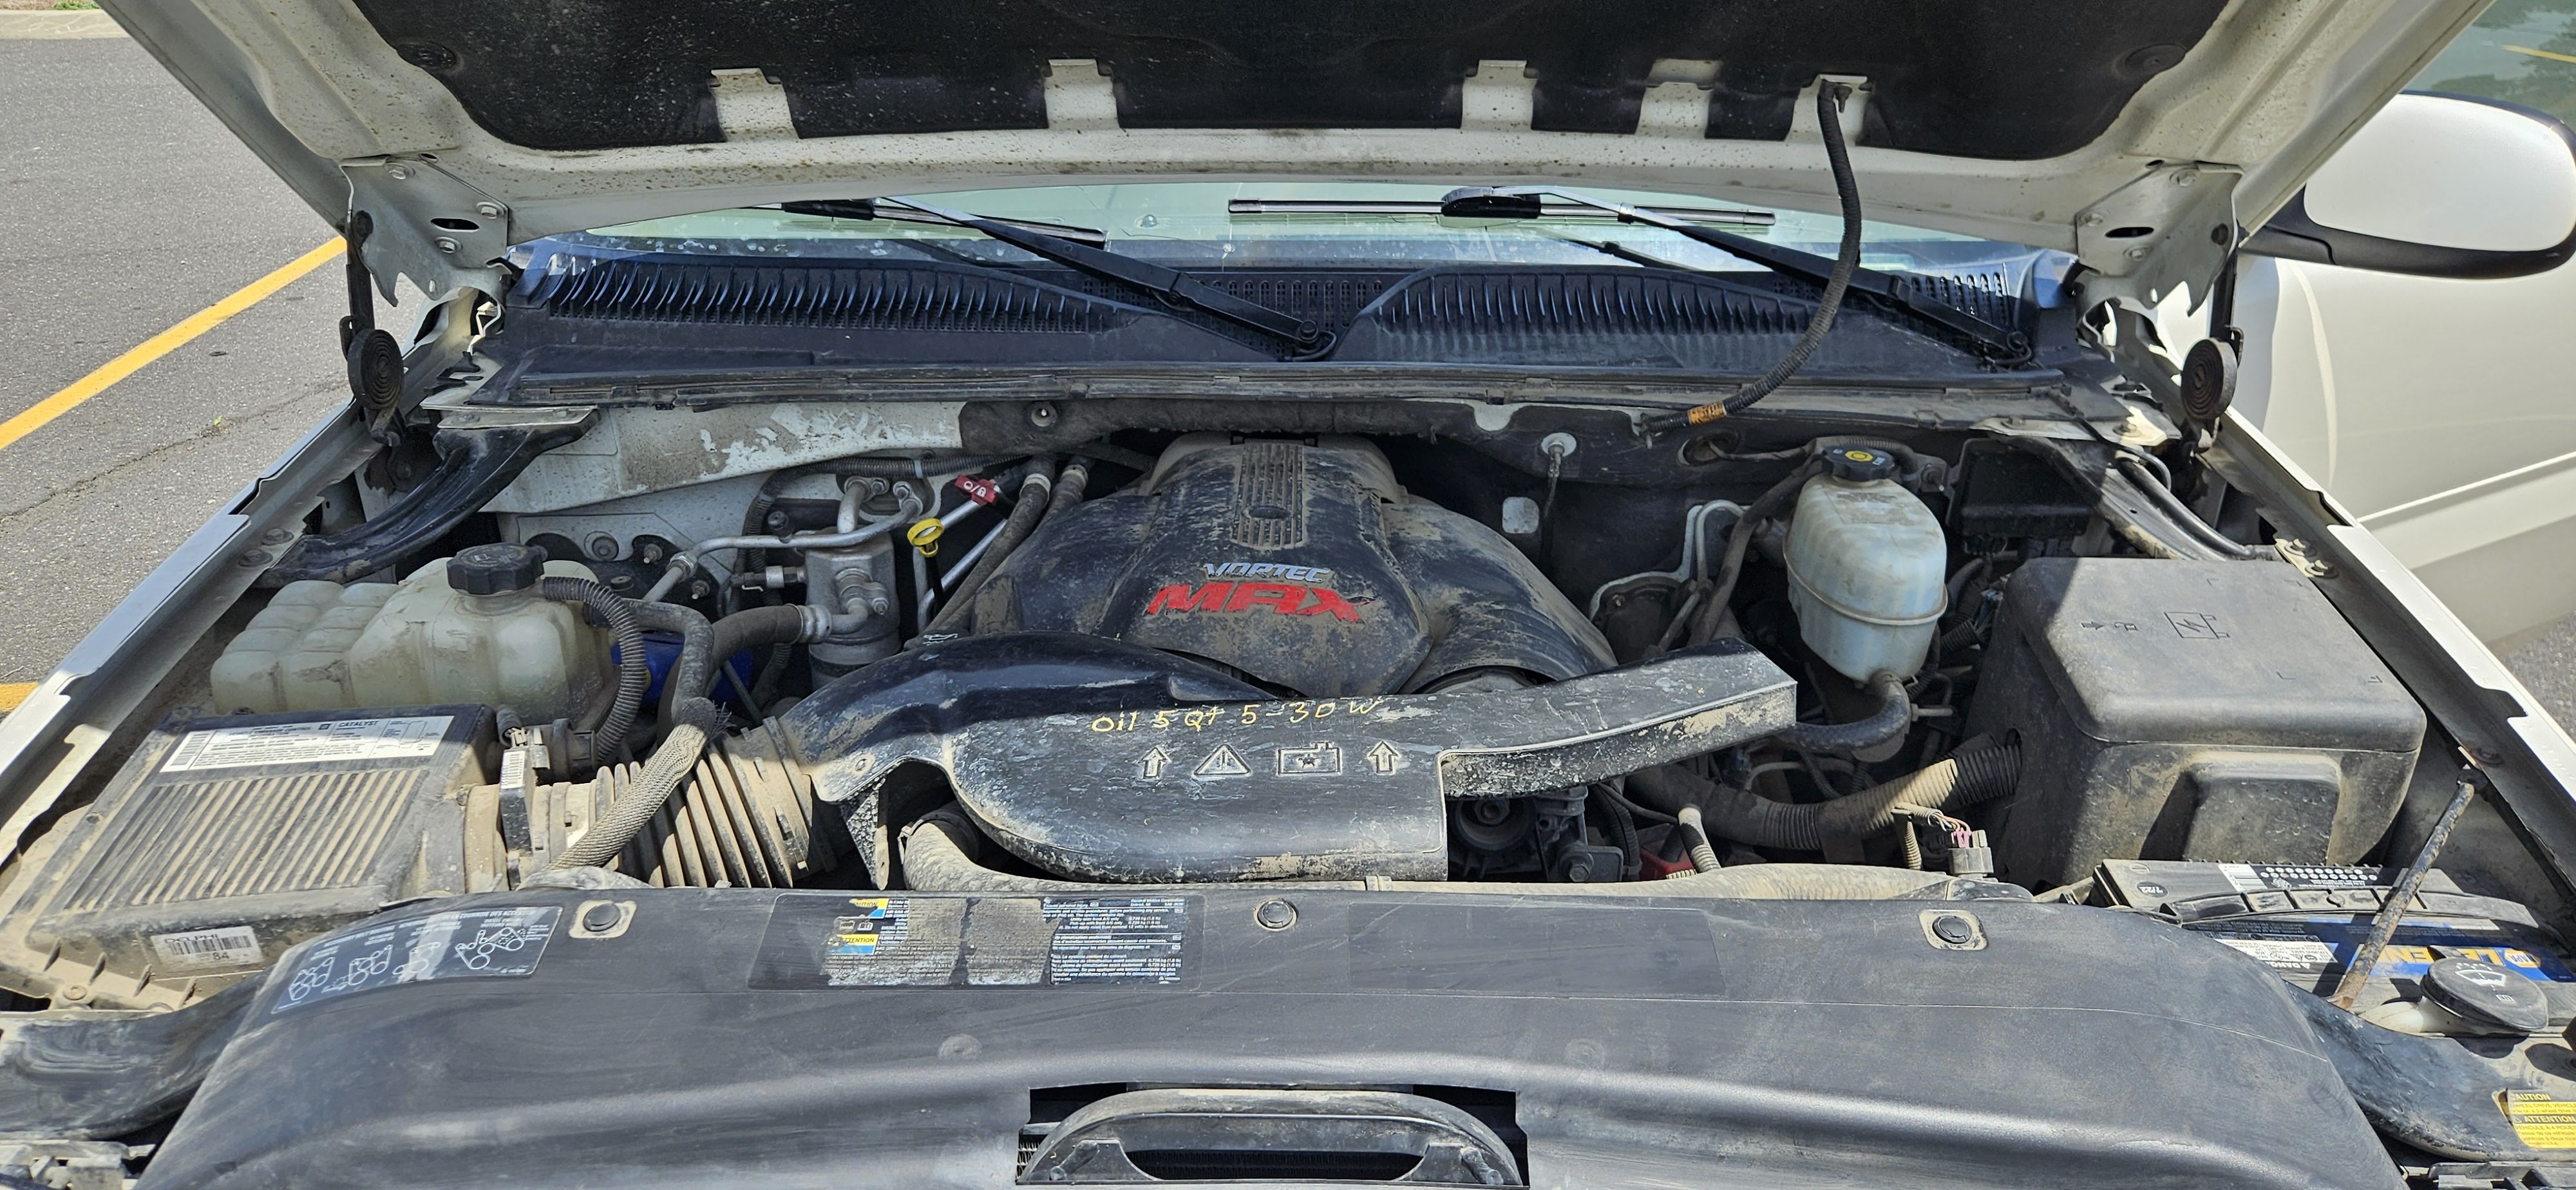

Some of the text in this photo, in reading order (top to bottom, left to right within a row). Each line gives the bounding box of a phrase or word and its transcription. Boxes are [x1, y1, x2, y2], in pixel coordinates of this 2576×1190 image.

[1203, 562, 1331, 583] VORTEC
[1144, 581, 1376, 623] MAX
[1091, 710, 1137, 732] Oil
[1153, 710, 1175, 728] 5
[165, 934, 218, 943] DELPHI
[213, 952, 229, 960] 84
